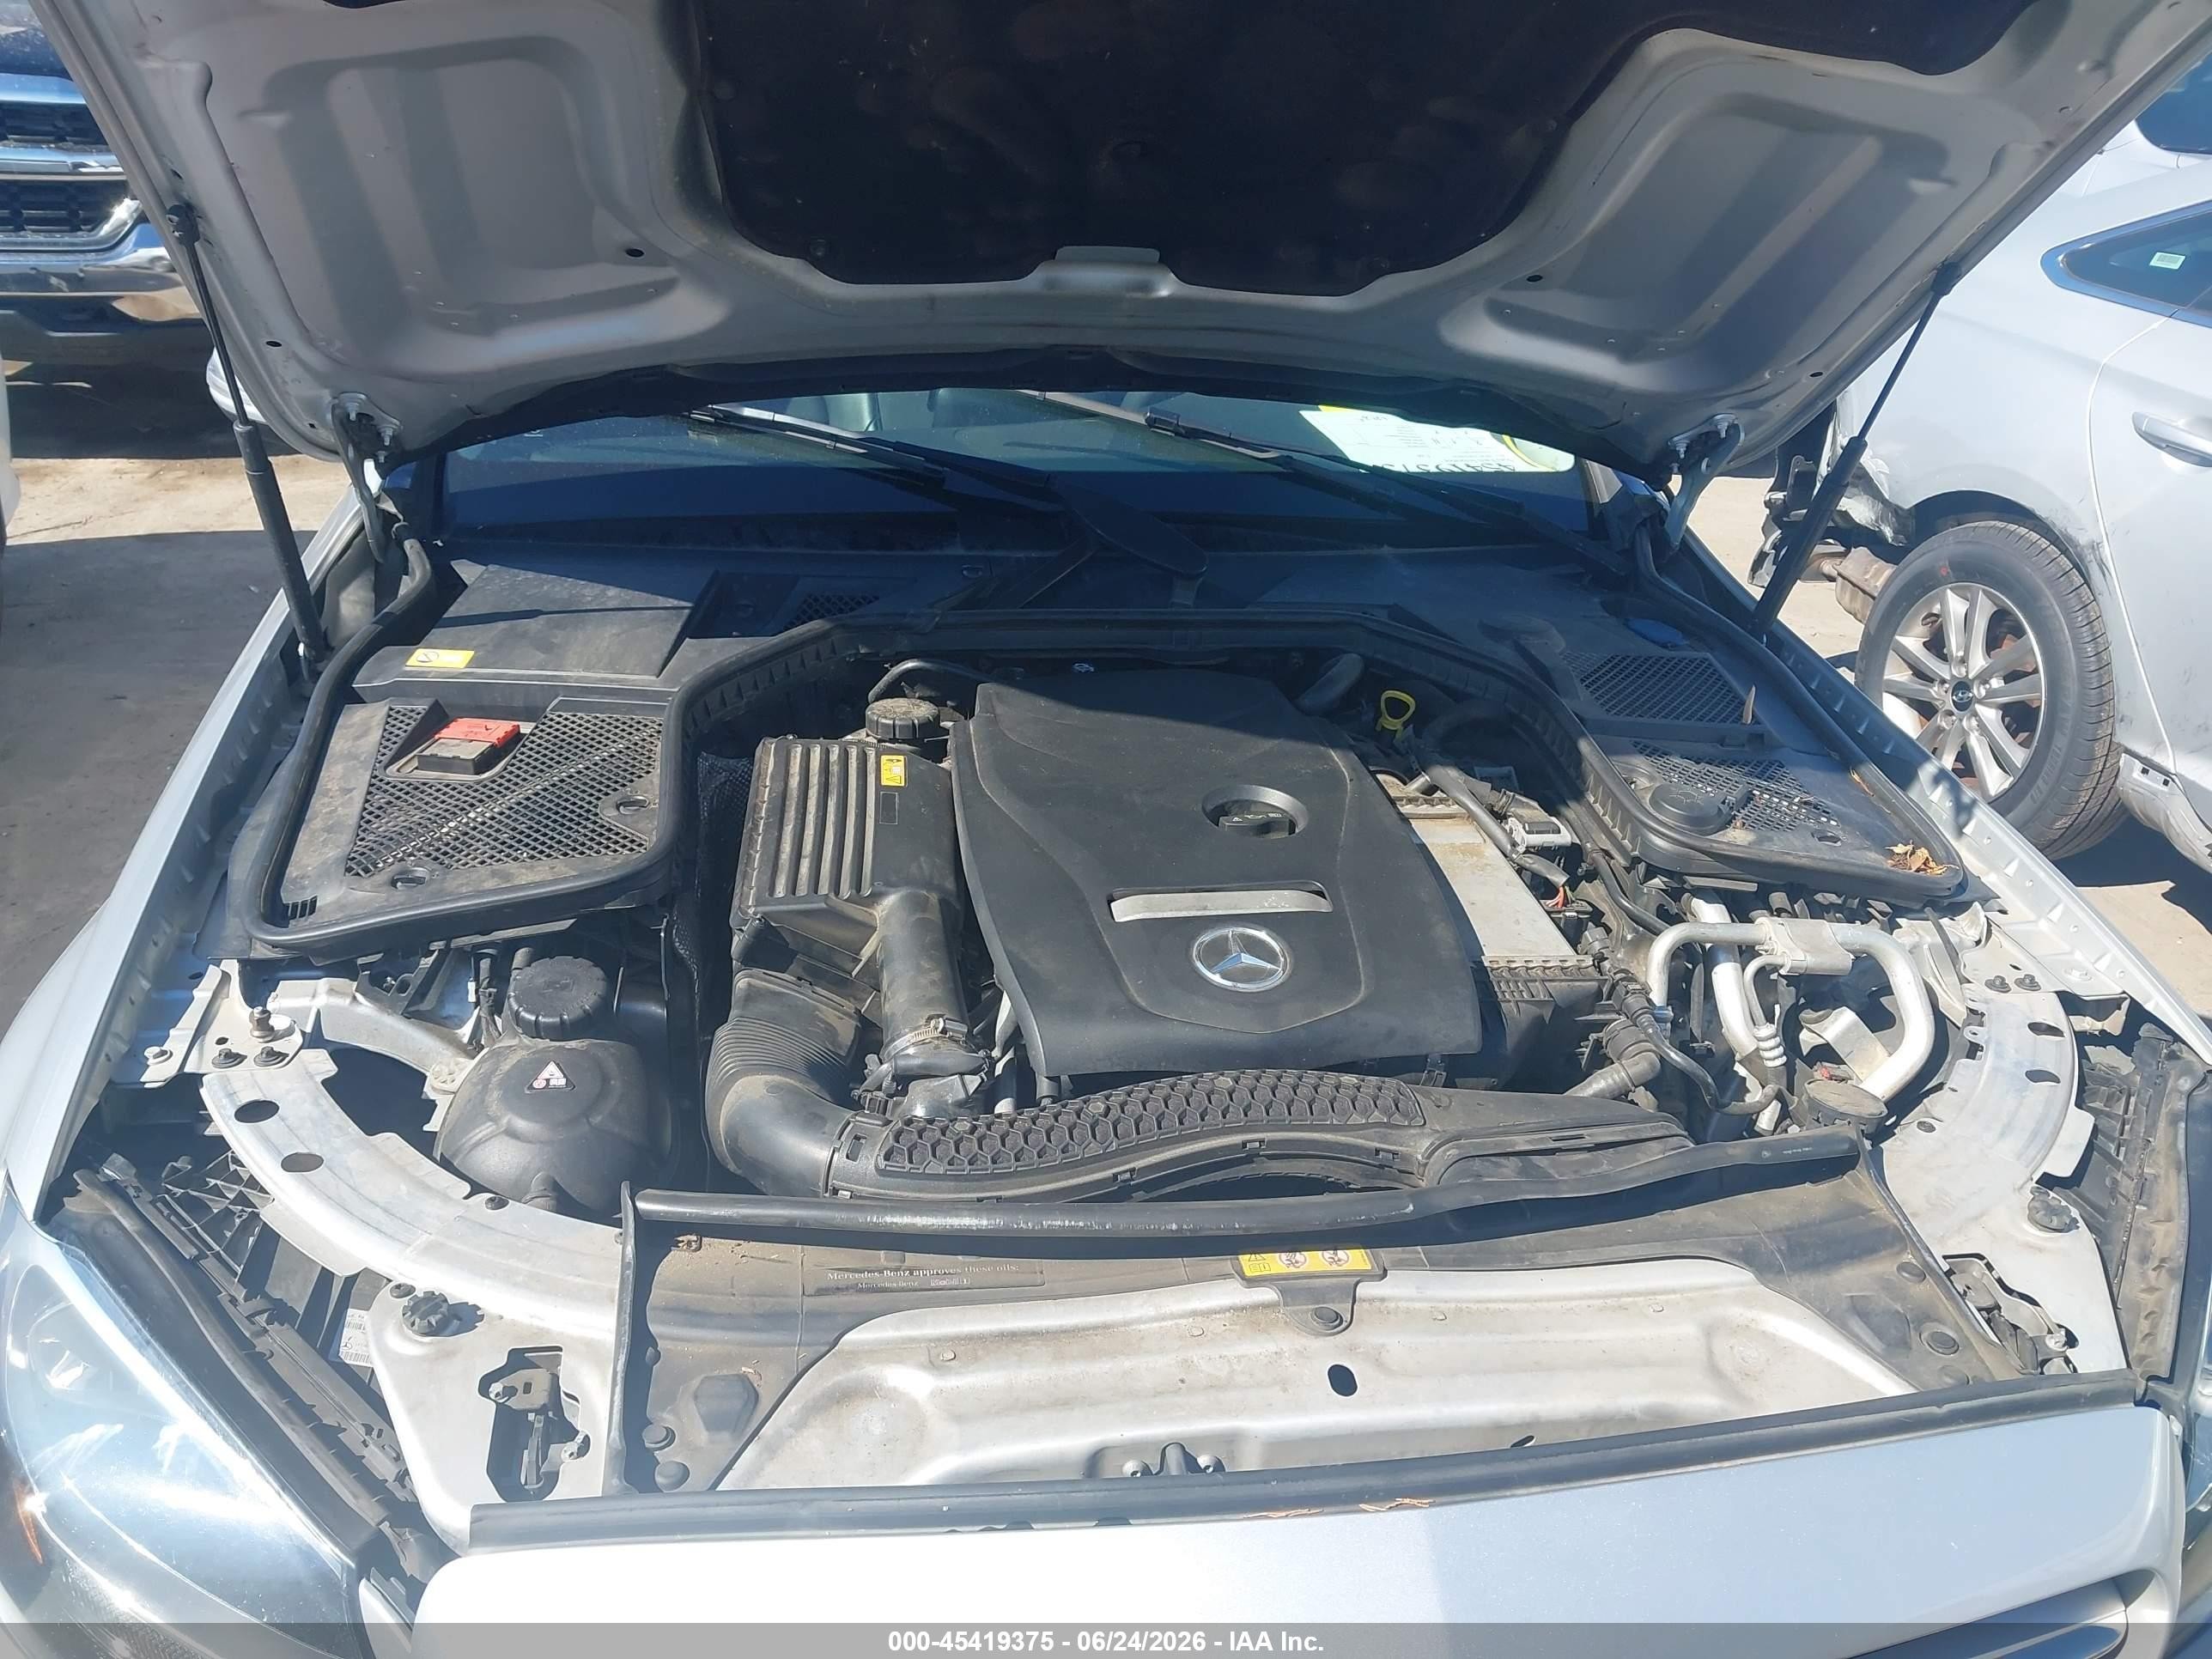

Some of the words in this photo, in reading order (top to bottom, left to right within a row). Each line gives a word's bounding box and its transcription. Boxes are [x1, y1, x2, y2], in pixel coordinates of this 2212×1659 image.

[827, 1269, 910, 1280] Mercedes-Benz
[913, 1267, 962, 1278] approves
[965, 1265, 994, 1273] these
[996, 1263, 1019, 1272] oils:
[857, 1280, 919, 1289] Mercedes-Benz
